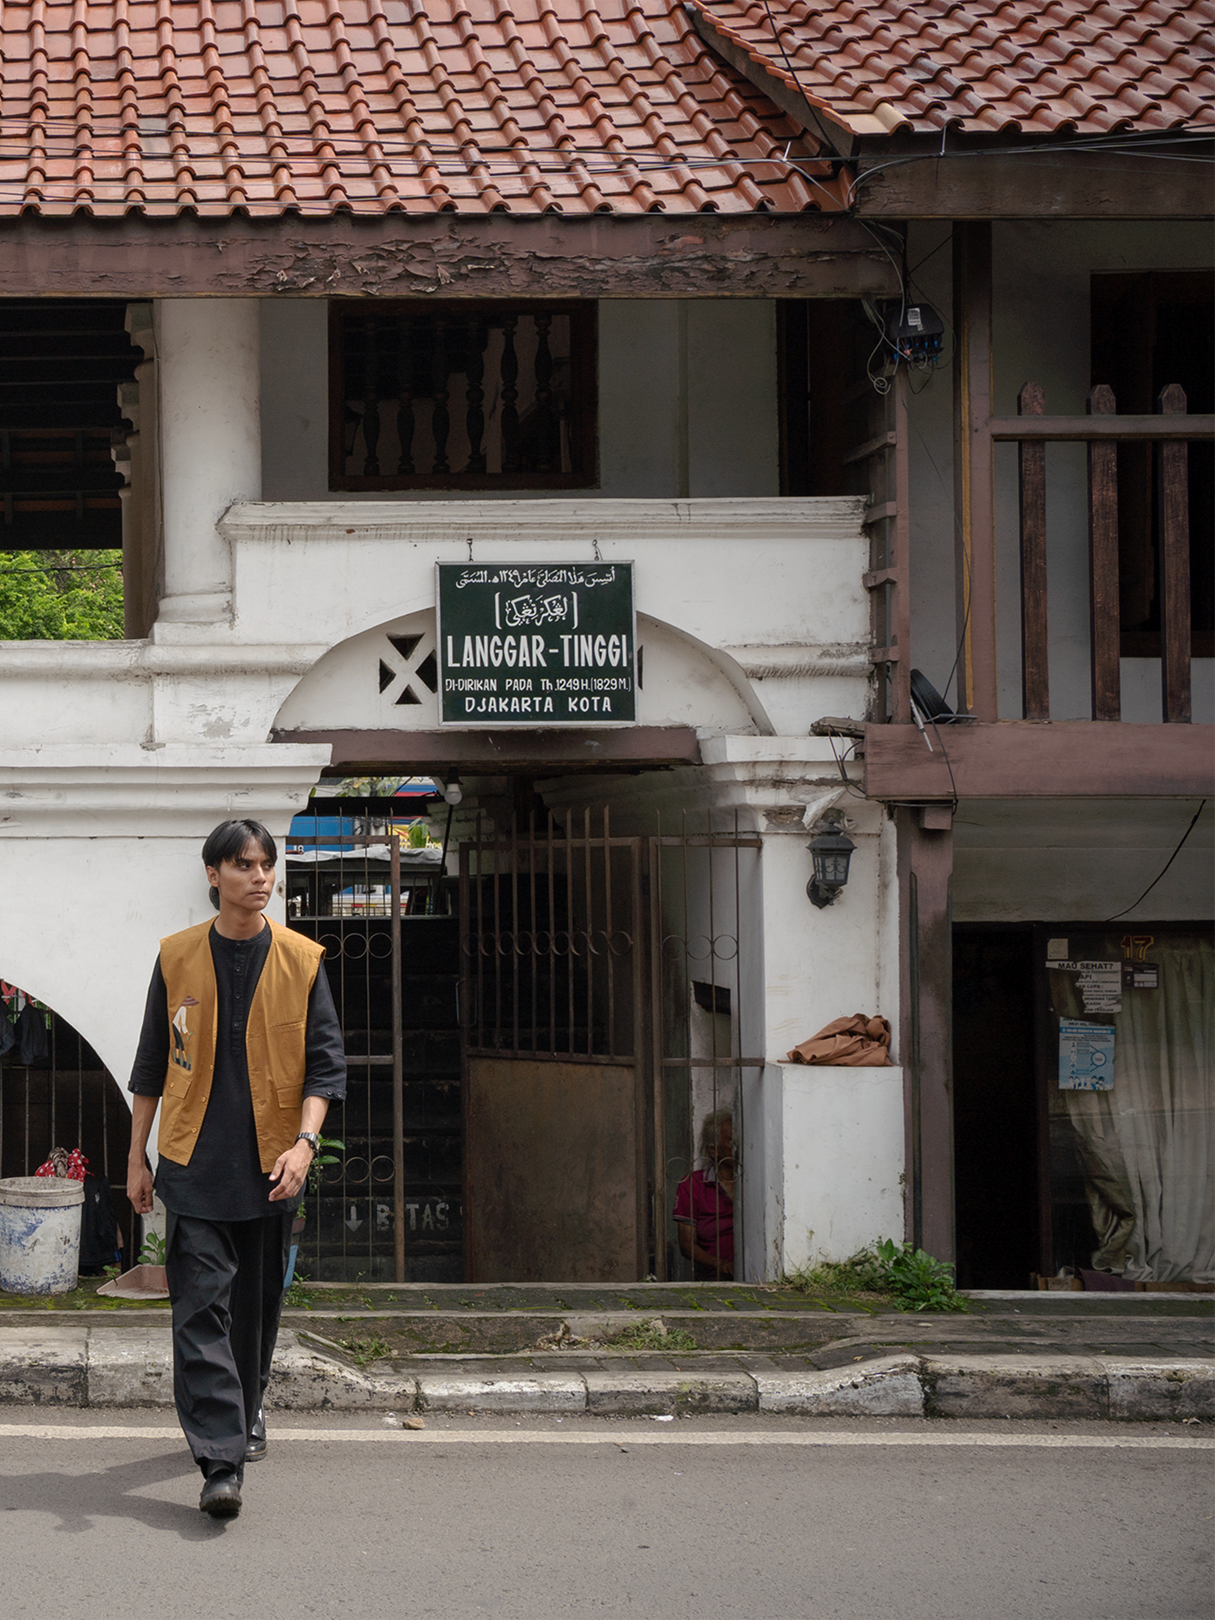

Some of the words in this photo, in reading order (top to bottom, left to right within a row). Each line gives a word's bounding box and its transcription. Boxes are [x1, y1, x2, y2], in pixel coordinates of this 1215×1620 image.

[445, 678, 497, 692] DI-DIRIKAN
[505, 678, 533, 692] PADA
[465, 696, 554, 713] DJAKARTA
[568, 696, 612, 713] KOTA
[1120, 935, 1154, 961] 17
[1080, 962, 1114, 970] SEHAT?
[377, 1202, 450, 1231] BTAS
